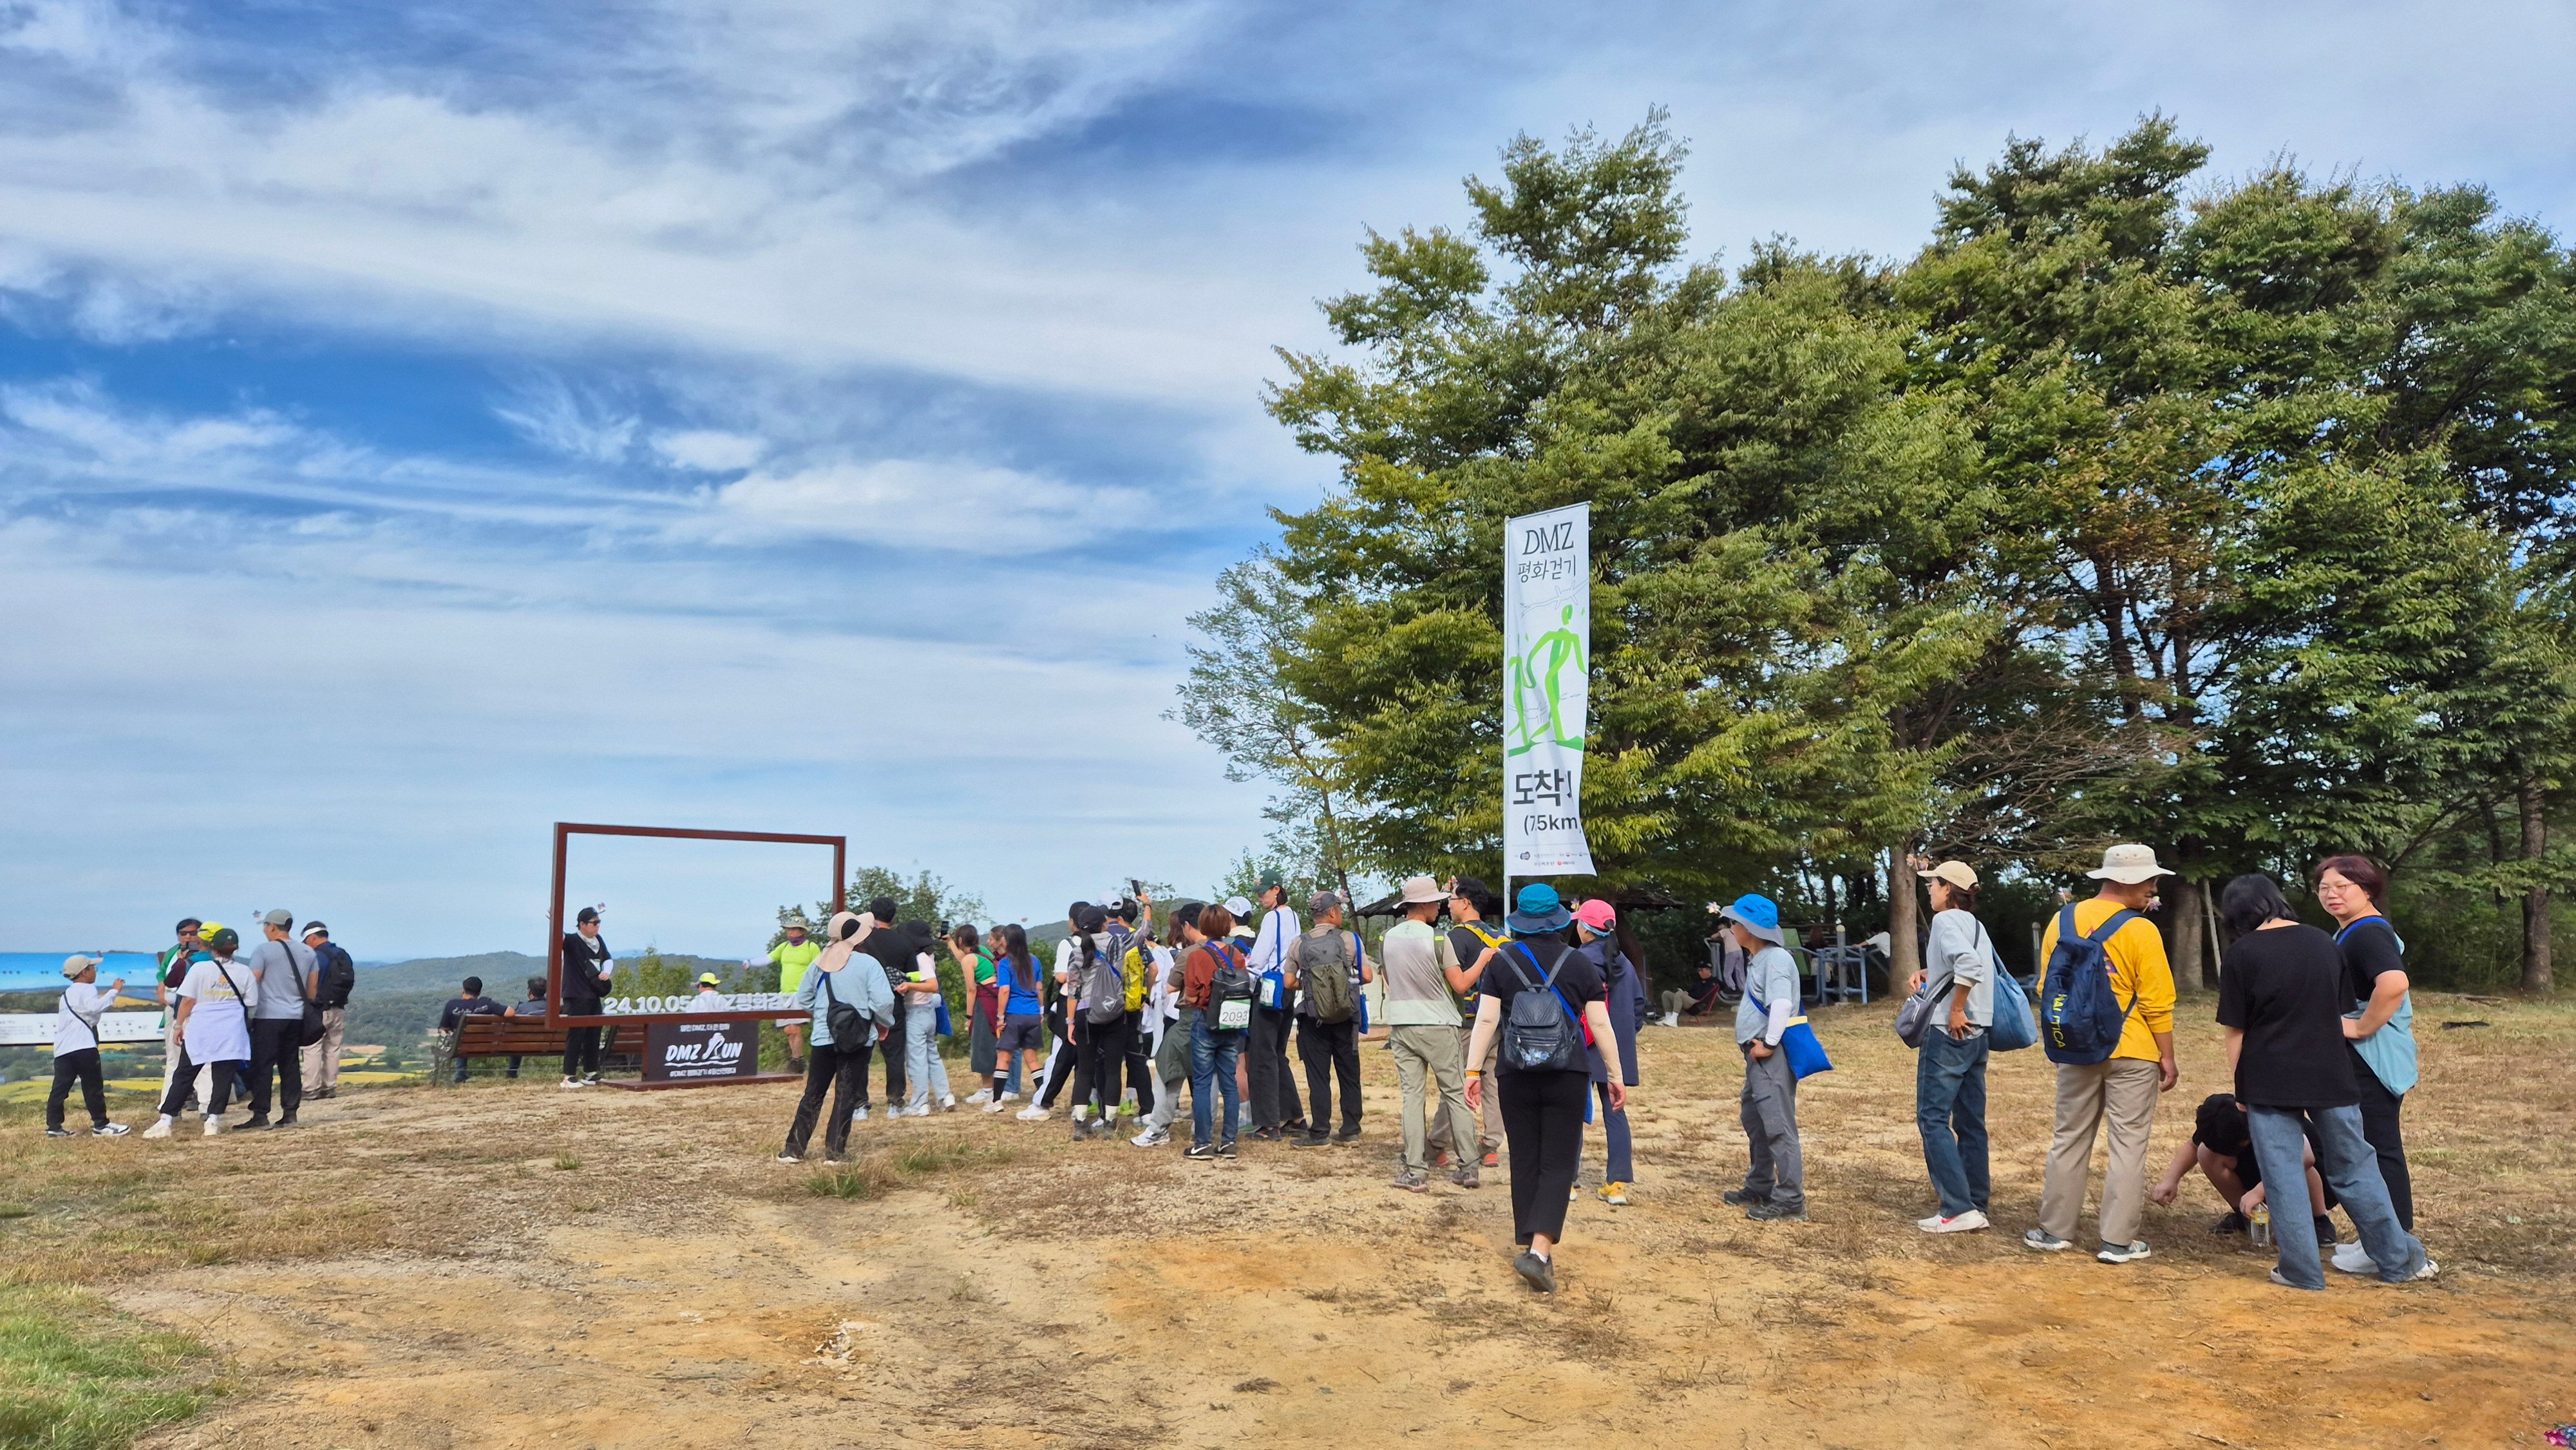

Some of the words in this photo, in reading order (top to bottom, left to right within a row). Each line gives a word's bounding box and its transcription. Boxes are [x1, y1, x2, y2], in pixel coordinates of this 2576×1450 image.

[1522, 522, 1574, 555] DMZ
[1518, 554, 1577, 583] 평화걷기
[1222, 1011, 1248, 1022] 2093
[665, 1044, 702, 1062] DMZ
